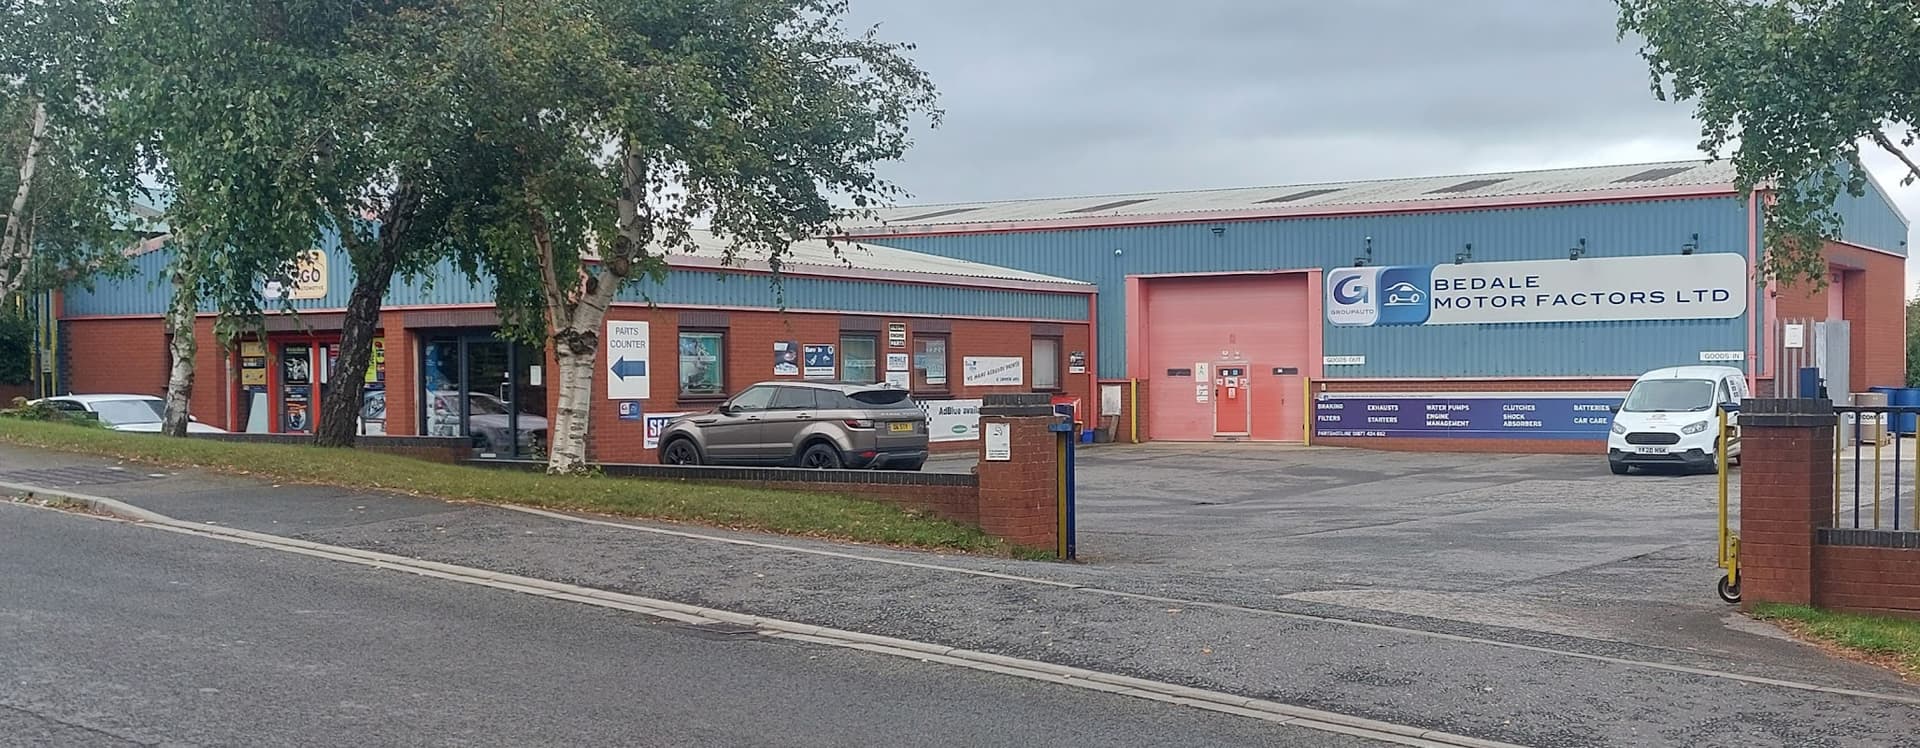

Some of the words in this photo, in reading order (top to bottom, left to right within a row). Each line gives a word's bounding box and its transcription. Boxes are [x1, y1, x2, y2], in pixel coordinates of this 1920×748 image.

[1434, 276, 1540, 290] BEDALE
[1434, 295, 1526, 309] MOTOR
[1536, 291, 1665, 307] FACTORS
[1677, 289, 1729, 303] LTD
[616, 326, 639, 336] PARTS
[610, 340, 646, 348] COUNTER
[939, 406, 962, 415] AdBlue
[962, 406, 980, 414] avail
